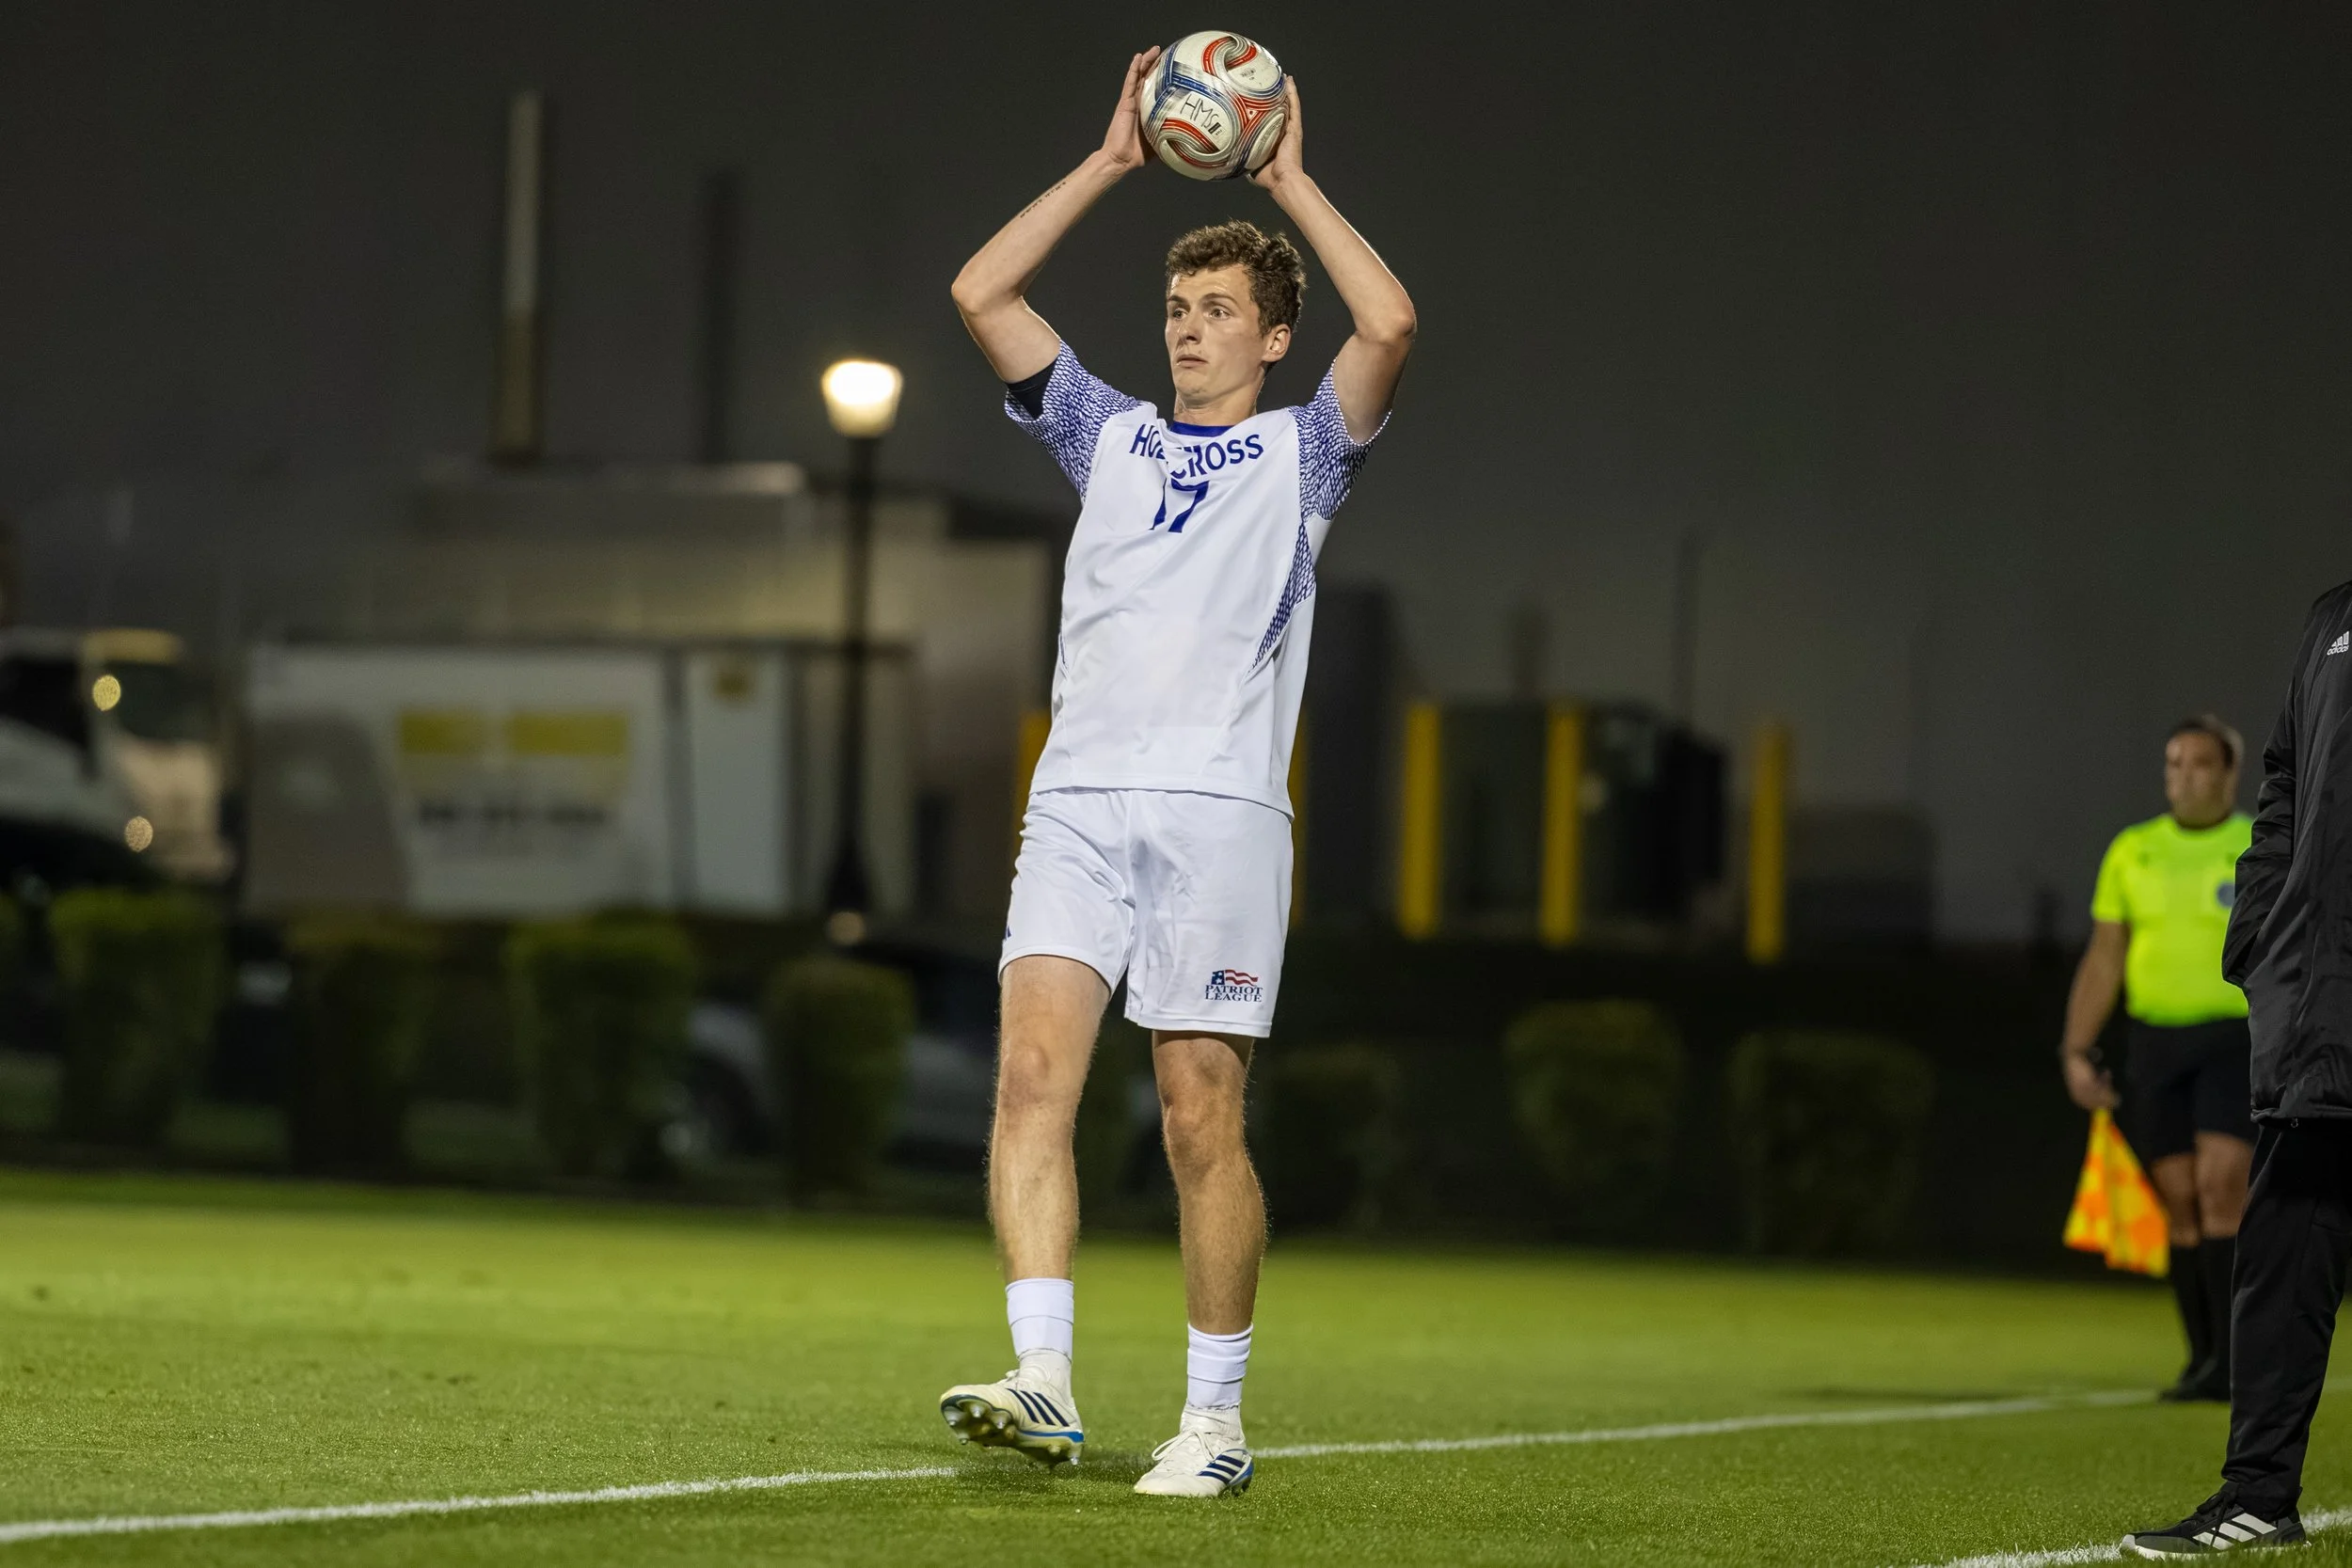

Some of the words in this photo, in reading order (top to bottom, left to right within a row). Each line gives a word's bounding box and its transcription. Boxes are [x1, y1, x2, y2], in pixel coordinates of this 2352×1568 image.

[1129, 423, 1168, 465] HO
[2327, 644, 2350, 656] adidas
[1205, 985, 1263, 995] PATRIOT
[1205, 992, 1263, 1003] LEAGUE
